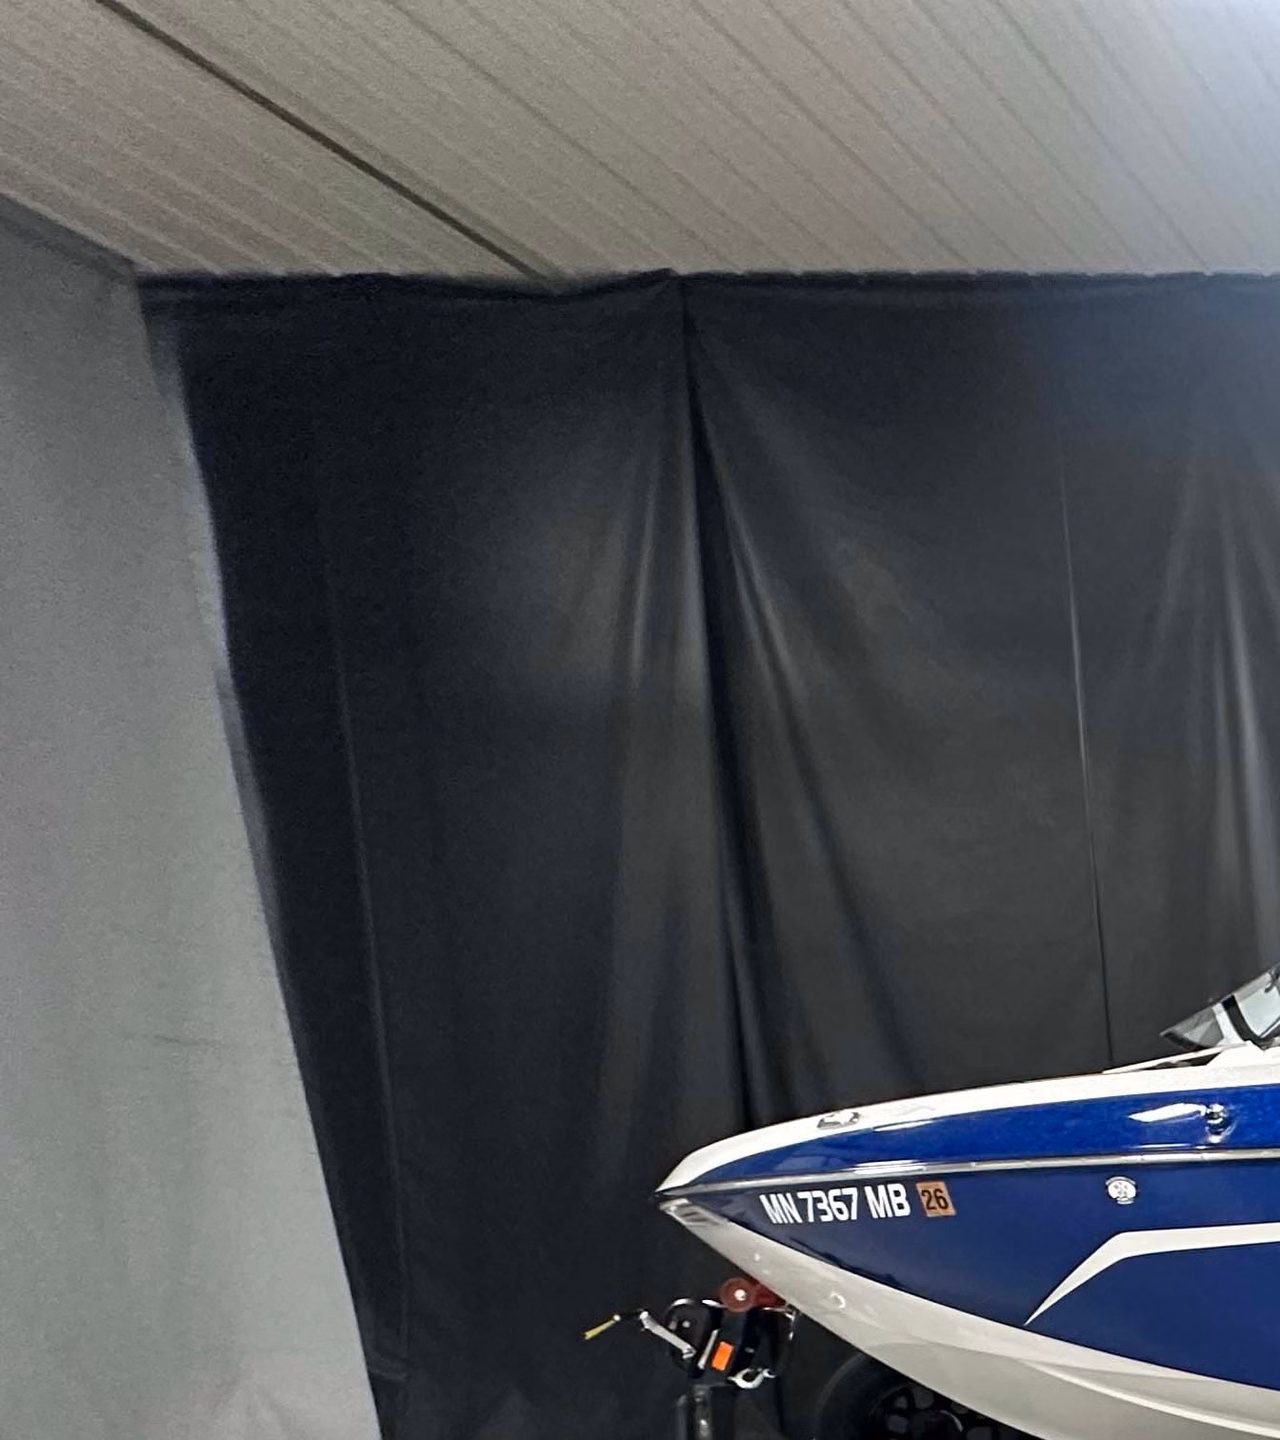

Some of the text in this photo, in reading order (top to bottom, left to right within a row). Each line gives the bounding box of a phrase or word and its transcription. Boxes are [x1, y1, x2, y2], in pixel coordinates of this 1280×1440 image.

[759, 1183, 911, 1224] MN 7367 MB
[921, 1188, 949, 1210] 26
